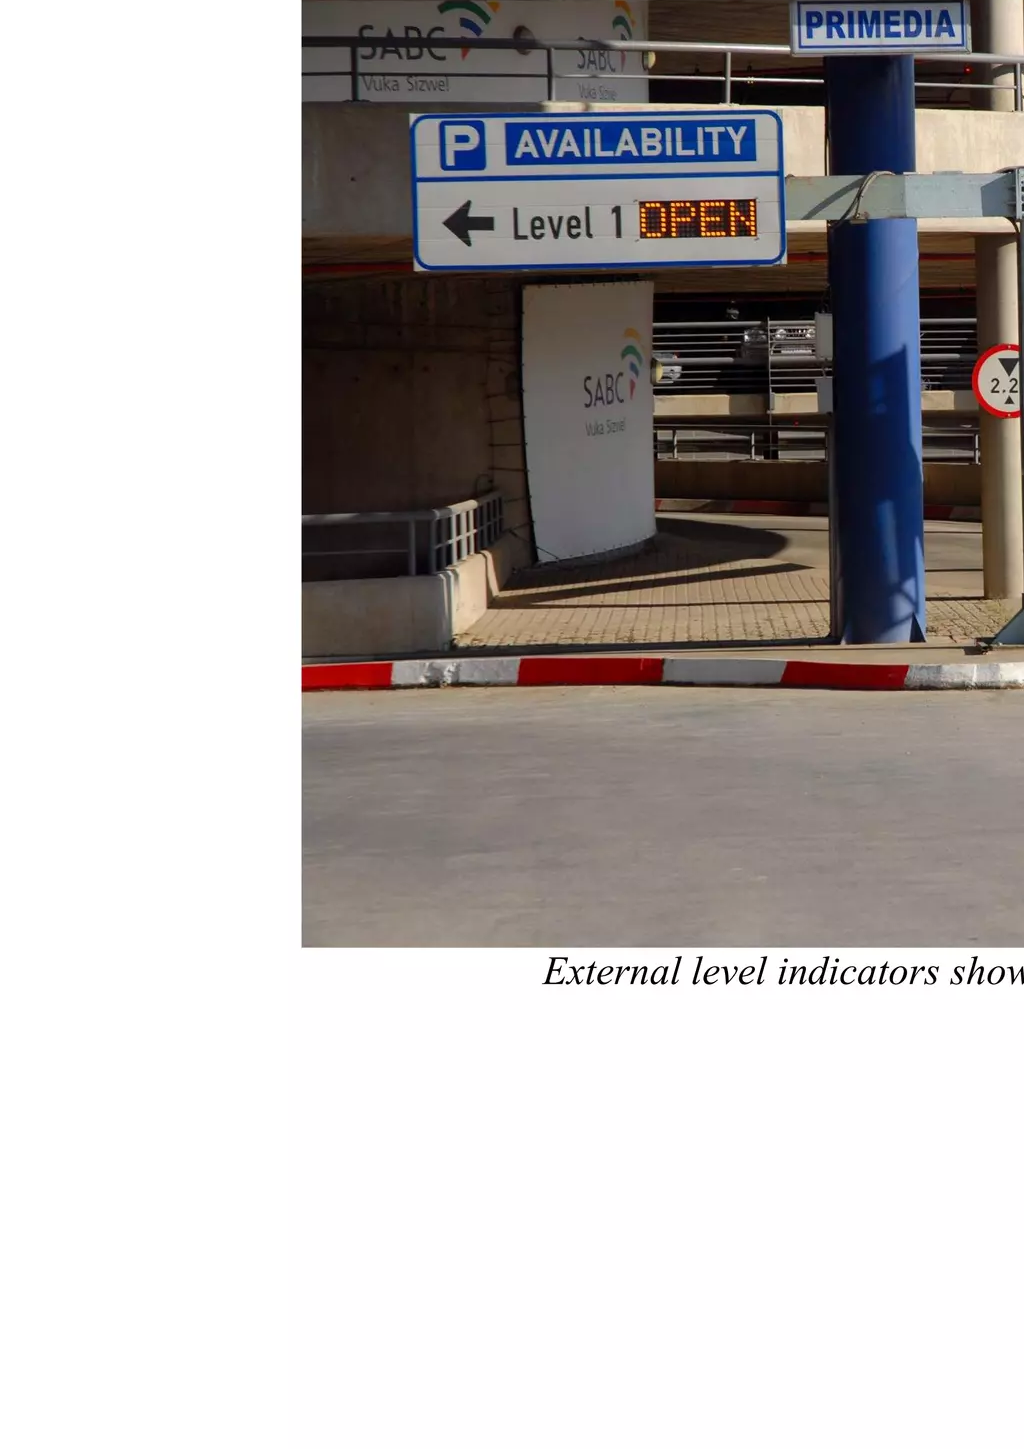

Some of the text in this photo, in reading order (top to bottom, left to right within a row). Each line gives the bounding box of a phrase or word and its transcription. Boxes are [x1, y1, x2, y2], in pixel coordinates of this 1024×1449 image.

[805, 9, 955, 39] PRIMEDIA
[358, 25, 447, 61] SABC
[362, 76, 450, 92] Vuka Sizwe!
[446, 125, 747, 166] P AVAILABILITY
[513, 201, 756, 240] Level 1 OPEN
[584, 372, 624, 408] SABC
